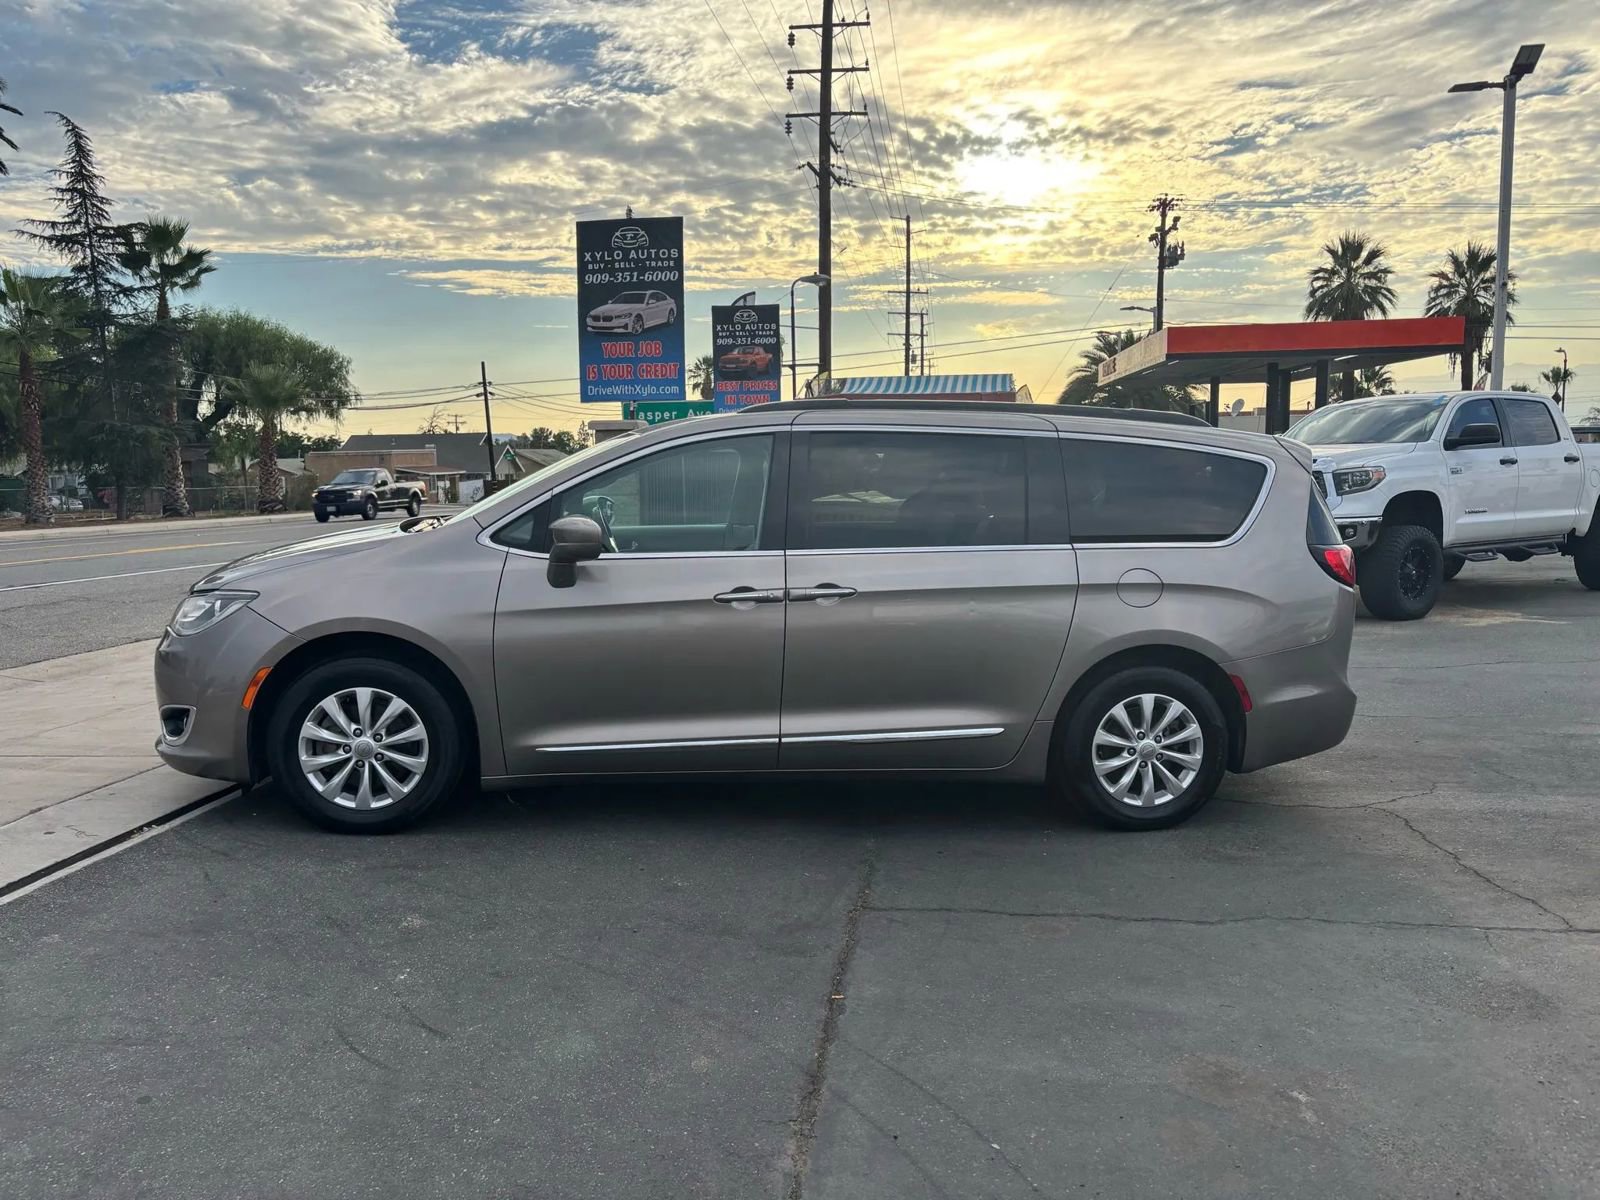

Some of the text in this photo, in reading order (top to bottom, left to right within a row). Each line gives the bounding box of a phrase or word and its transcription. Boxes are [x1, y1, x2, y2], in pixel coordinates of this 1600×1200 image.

[584, 248, 679, 262] XYLO AUTOS
[645, 260, 675, 268] TRADE
[584, 270, 679, 285] 909-351-6000
[716, 323, 777, 332] XYLO AUTOS
[716, 337, 777, 346] 909-351-6000
[601, 340, 663, 358] YOUR JOB
[586, 362, 680, 381] IS YOUR CREDIT
[588, 384, 680, 397] DriveWithXylo.com
[717, 380, 778, 392] BEST PRICES
[725, 393, 770, 405] IN TOWN
[632, 410, 677, 422] asper
